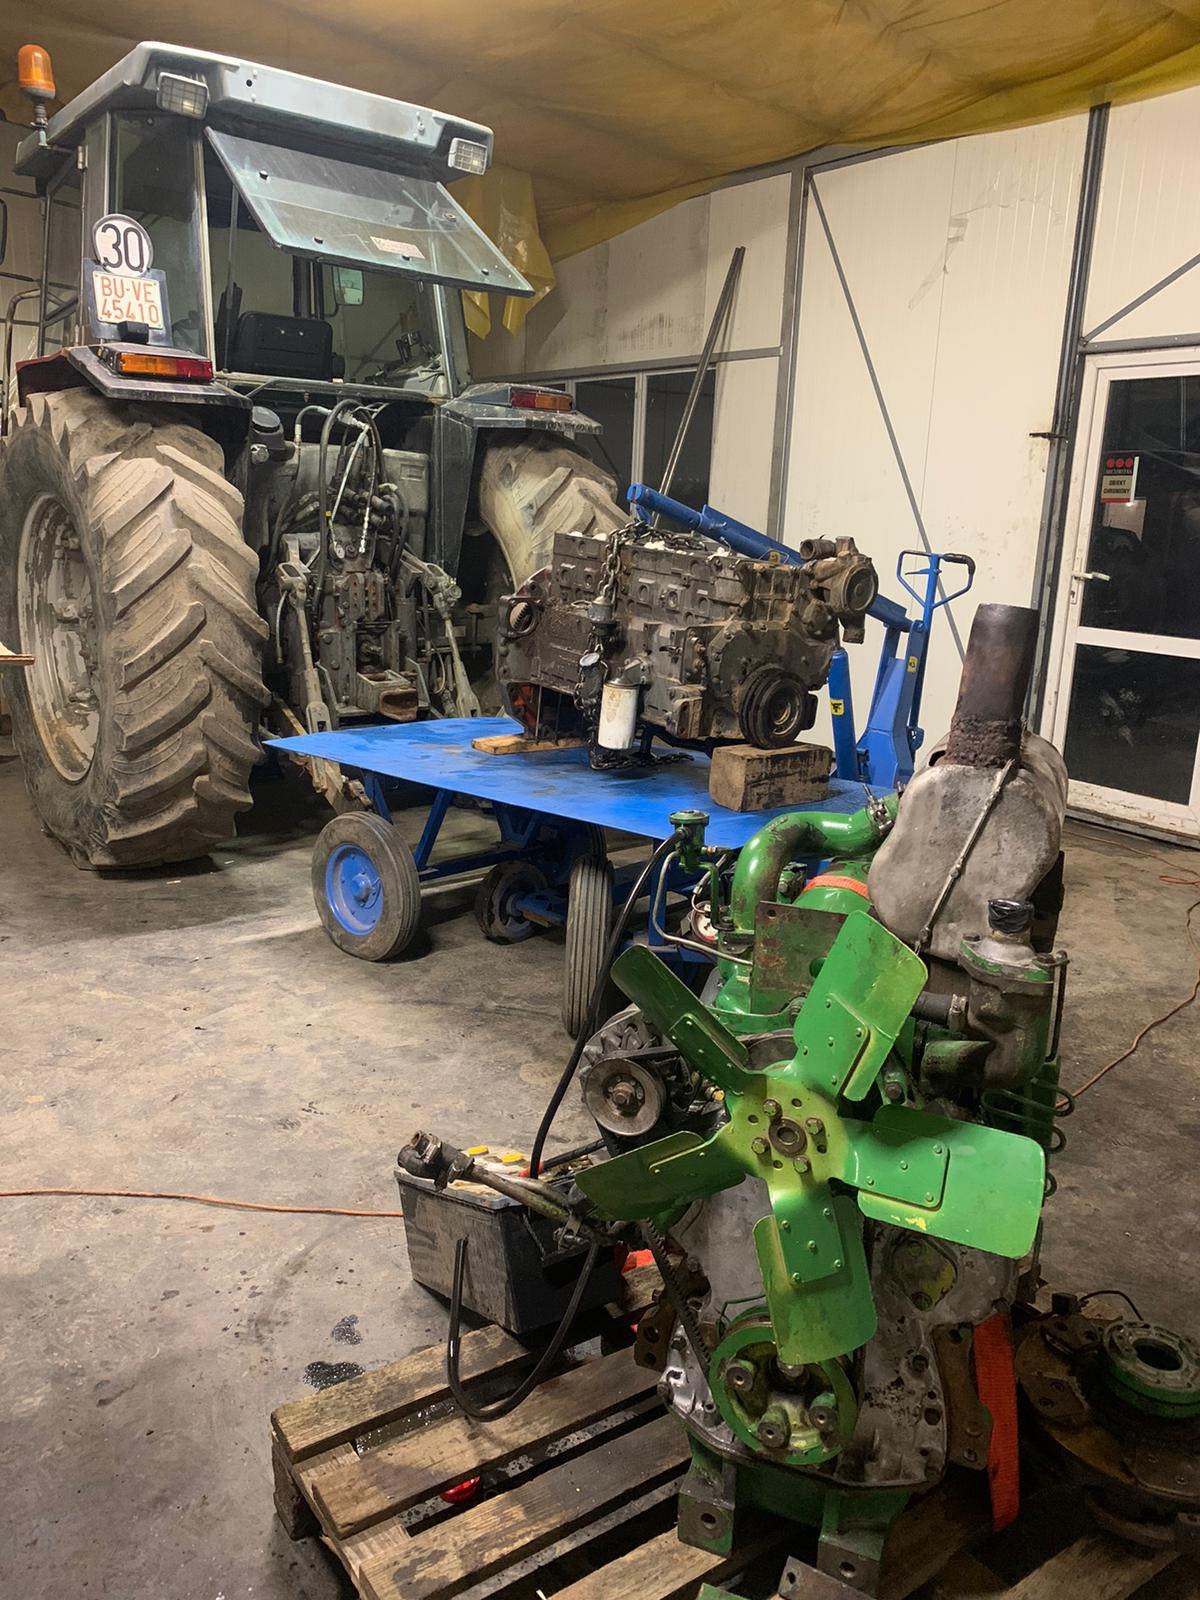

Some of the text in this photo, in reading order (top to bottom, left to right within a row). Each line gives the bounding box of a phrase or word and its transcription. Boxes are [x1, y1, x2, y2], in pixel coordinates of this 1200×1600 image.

[101, 223, 145, 272] 30
[100, 275, 154, 303] BU-VE
[101, 299, 159, 324] 45410
